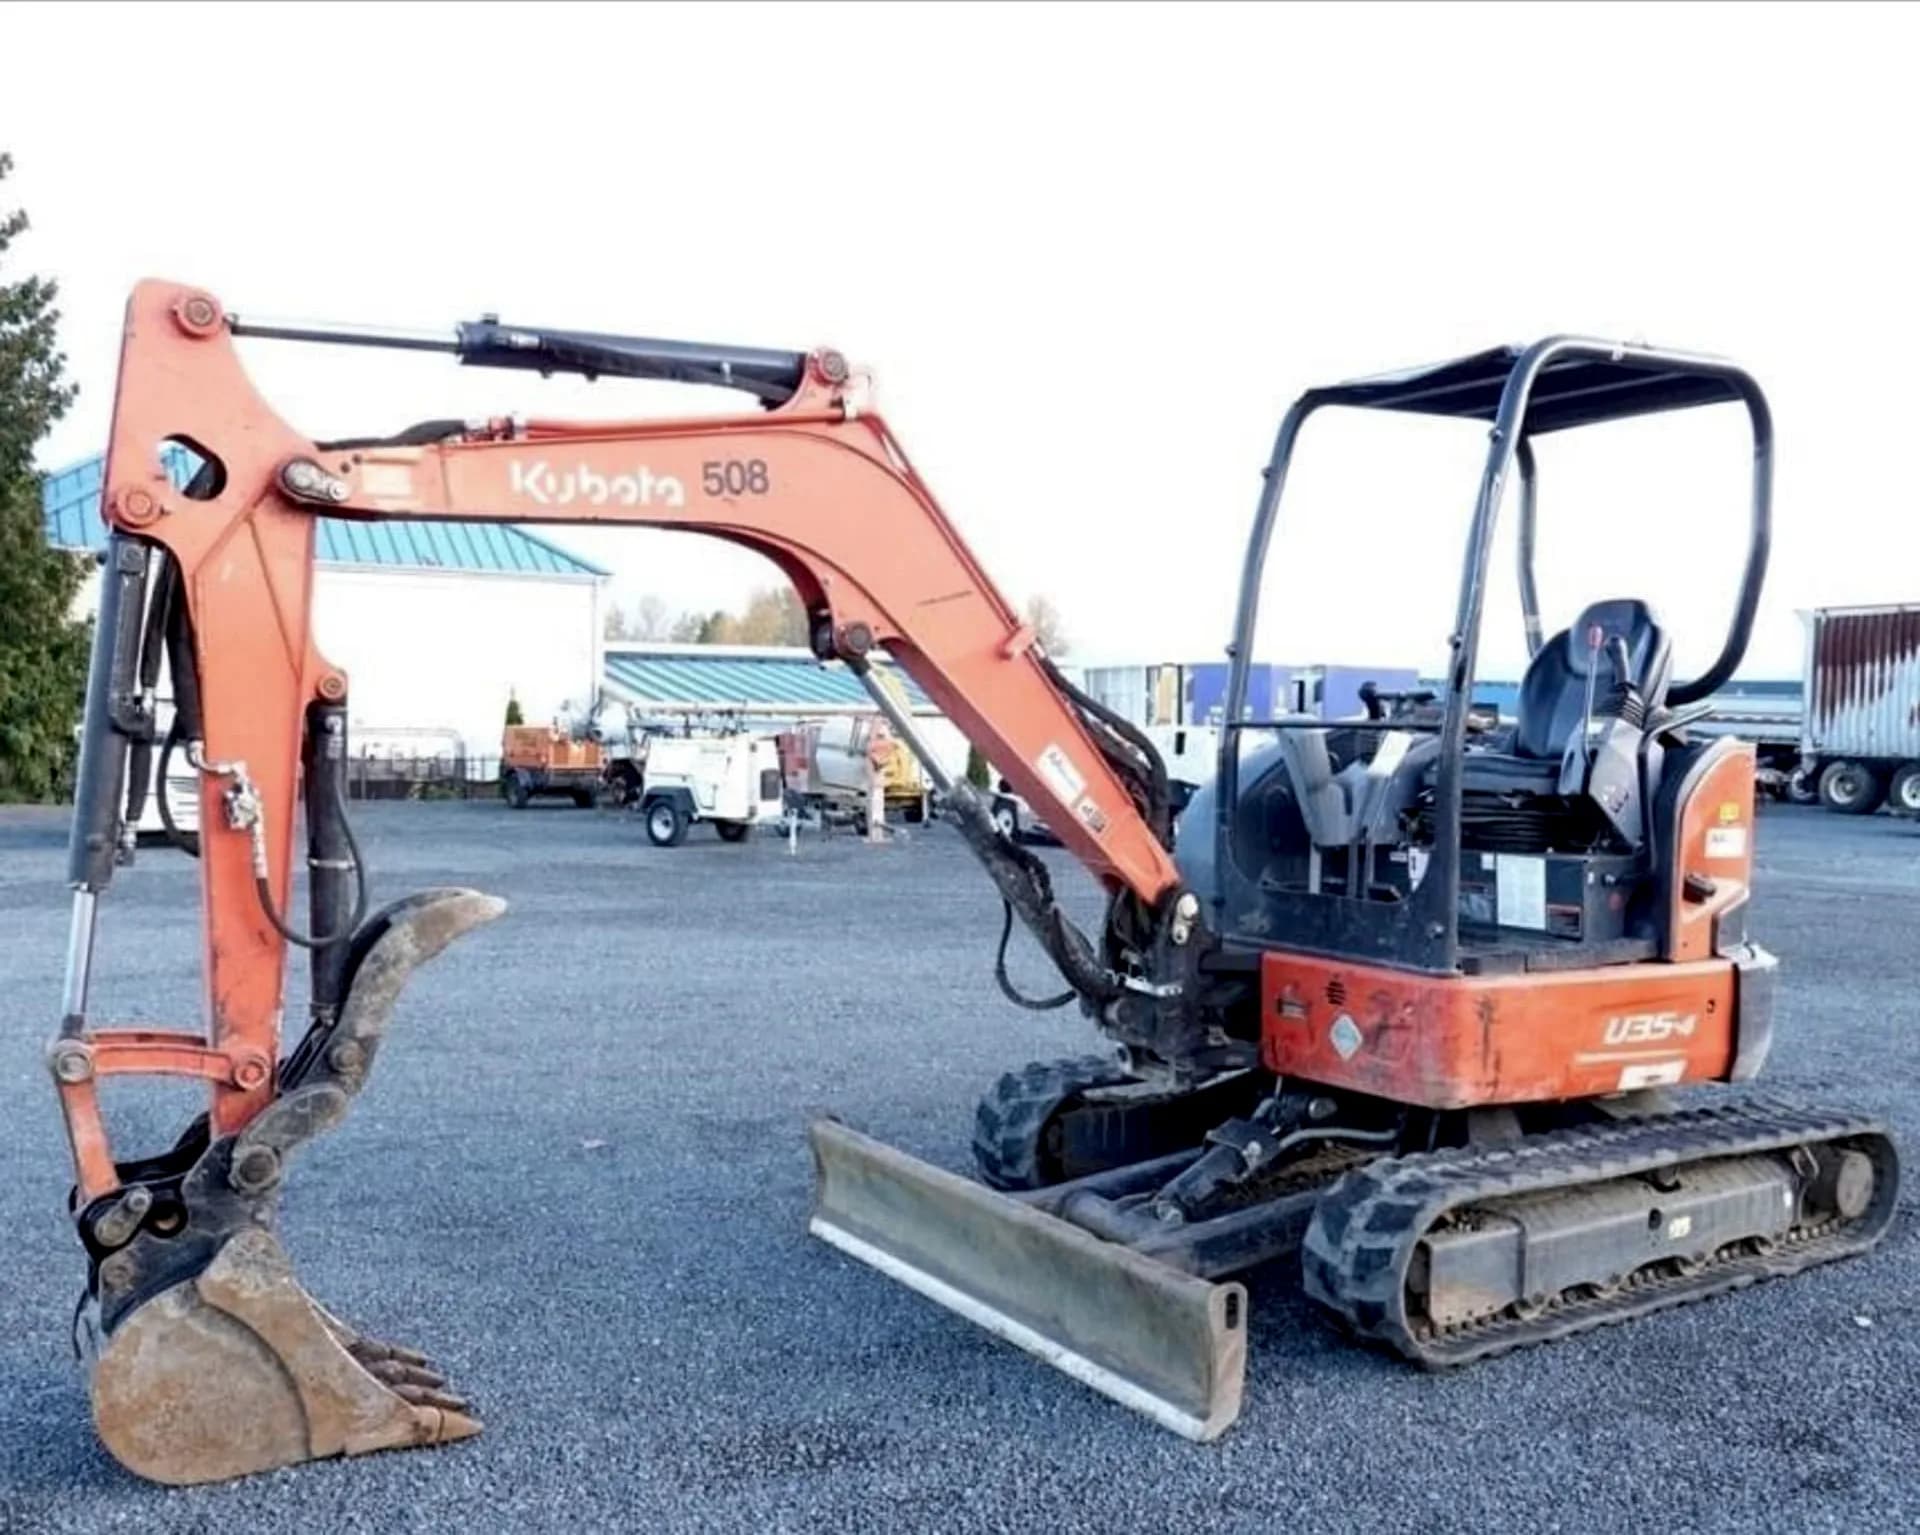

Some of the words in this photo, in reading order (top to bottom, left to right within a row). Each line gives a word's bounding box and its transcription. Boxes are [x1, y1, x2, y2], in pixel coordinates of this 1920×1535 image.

[510, 459, 685, 507] Kubota
[702, 459, 769, 496] 508
[1603, 1012, 1696, 1045] U35-4
